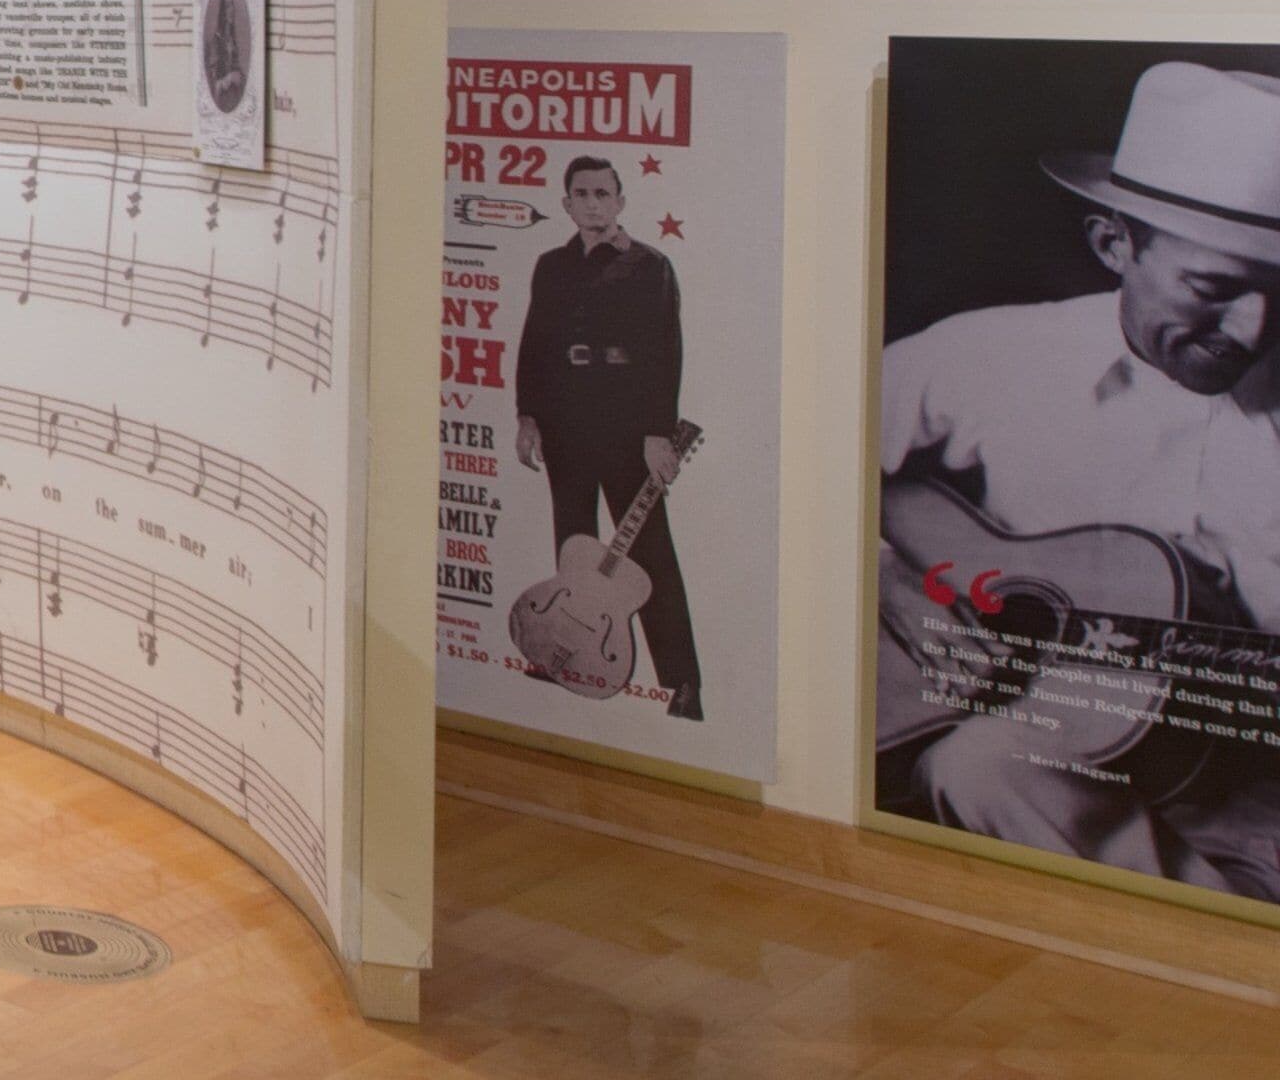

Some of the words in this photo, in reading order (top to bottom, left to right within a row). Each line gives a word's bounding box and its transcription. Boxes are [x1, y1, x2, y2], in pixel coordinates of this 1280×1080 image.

[447, 65, 618, 92] NEAPOLIS
[447, 70, 678, 138] ITORIUM
[499, 144, 547, 187] 22
[442, 296, 500, 330] NY
[444, 450, 498, 478] THREE
[42, 485, 62, 501] on
[95, 497, 119, 521] the
[137, 518, 167, 541] sum
[179, 533, 207, 559] mer
[446, 538, 492, 566] BROS.
[446, 643, 489, 664] $1.50
[624, 682, 670, 703] $2.00
[950, 647, 990, 665] blues
[1040, 664, 1092, 684] people
[1096, 671, 1129, 691] that
[1175, 687, 1235, 715] during
[952, 625, 998, 641] music
[1002, 632, 1032, 648] was
[1036, 639, 1137, 670] newsworthy.
[1158, 660, 1193, 678] was
[1196, 665, 1245, 686] about
[1249, 675, 1278, 692] the
[1029, 685, 1091, 710] Jimmie
[1094, 696, 1164, 723] Rodgers
[1167, 711, 1201, 731] was
[1205, 721, 1239, 738] one
[1028, 752, 1069, 771] Merle
[1071, 759, 1132, 785] Haggard
